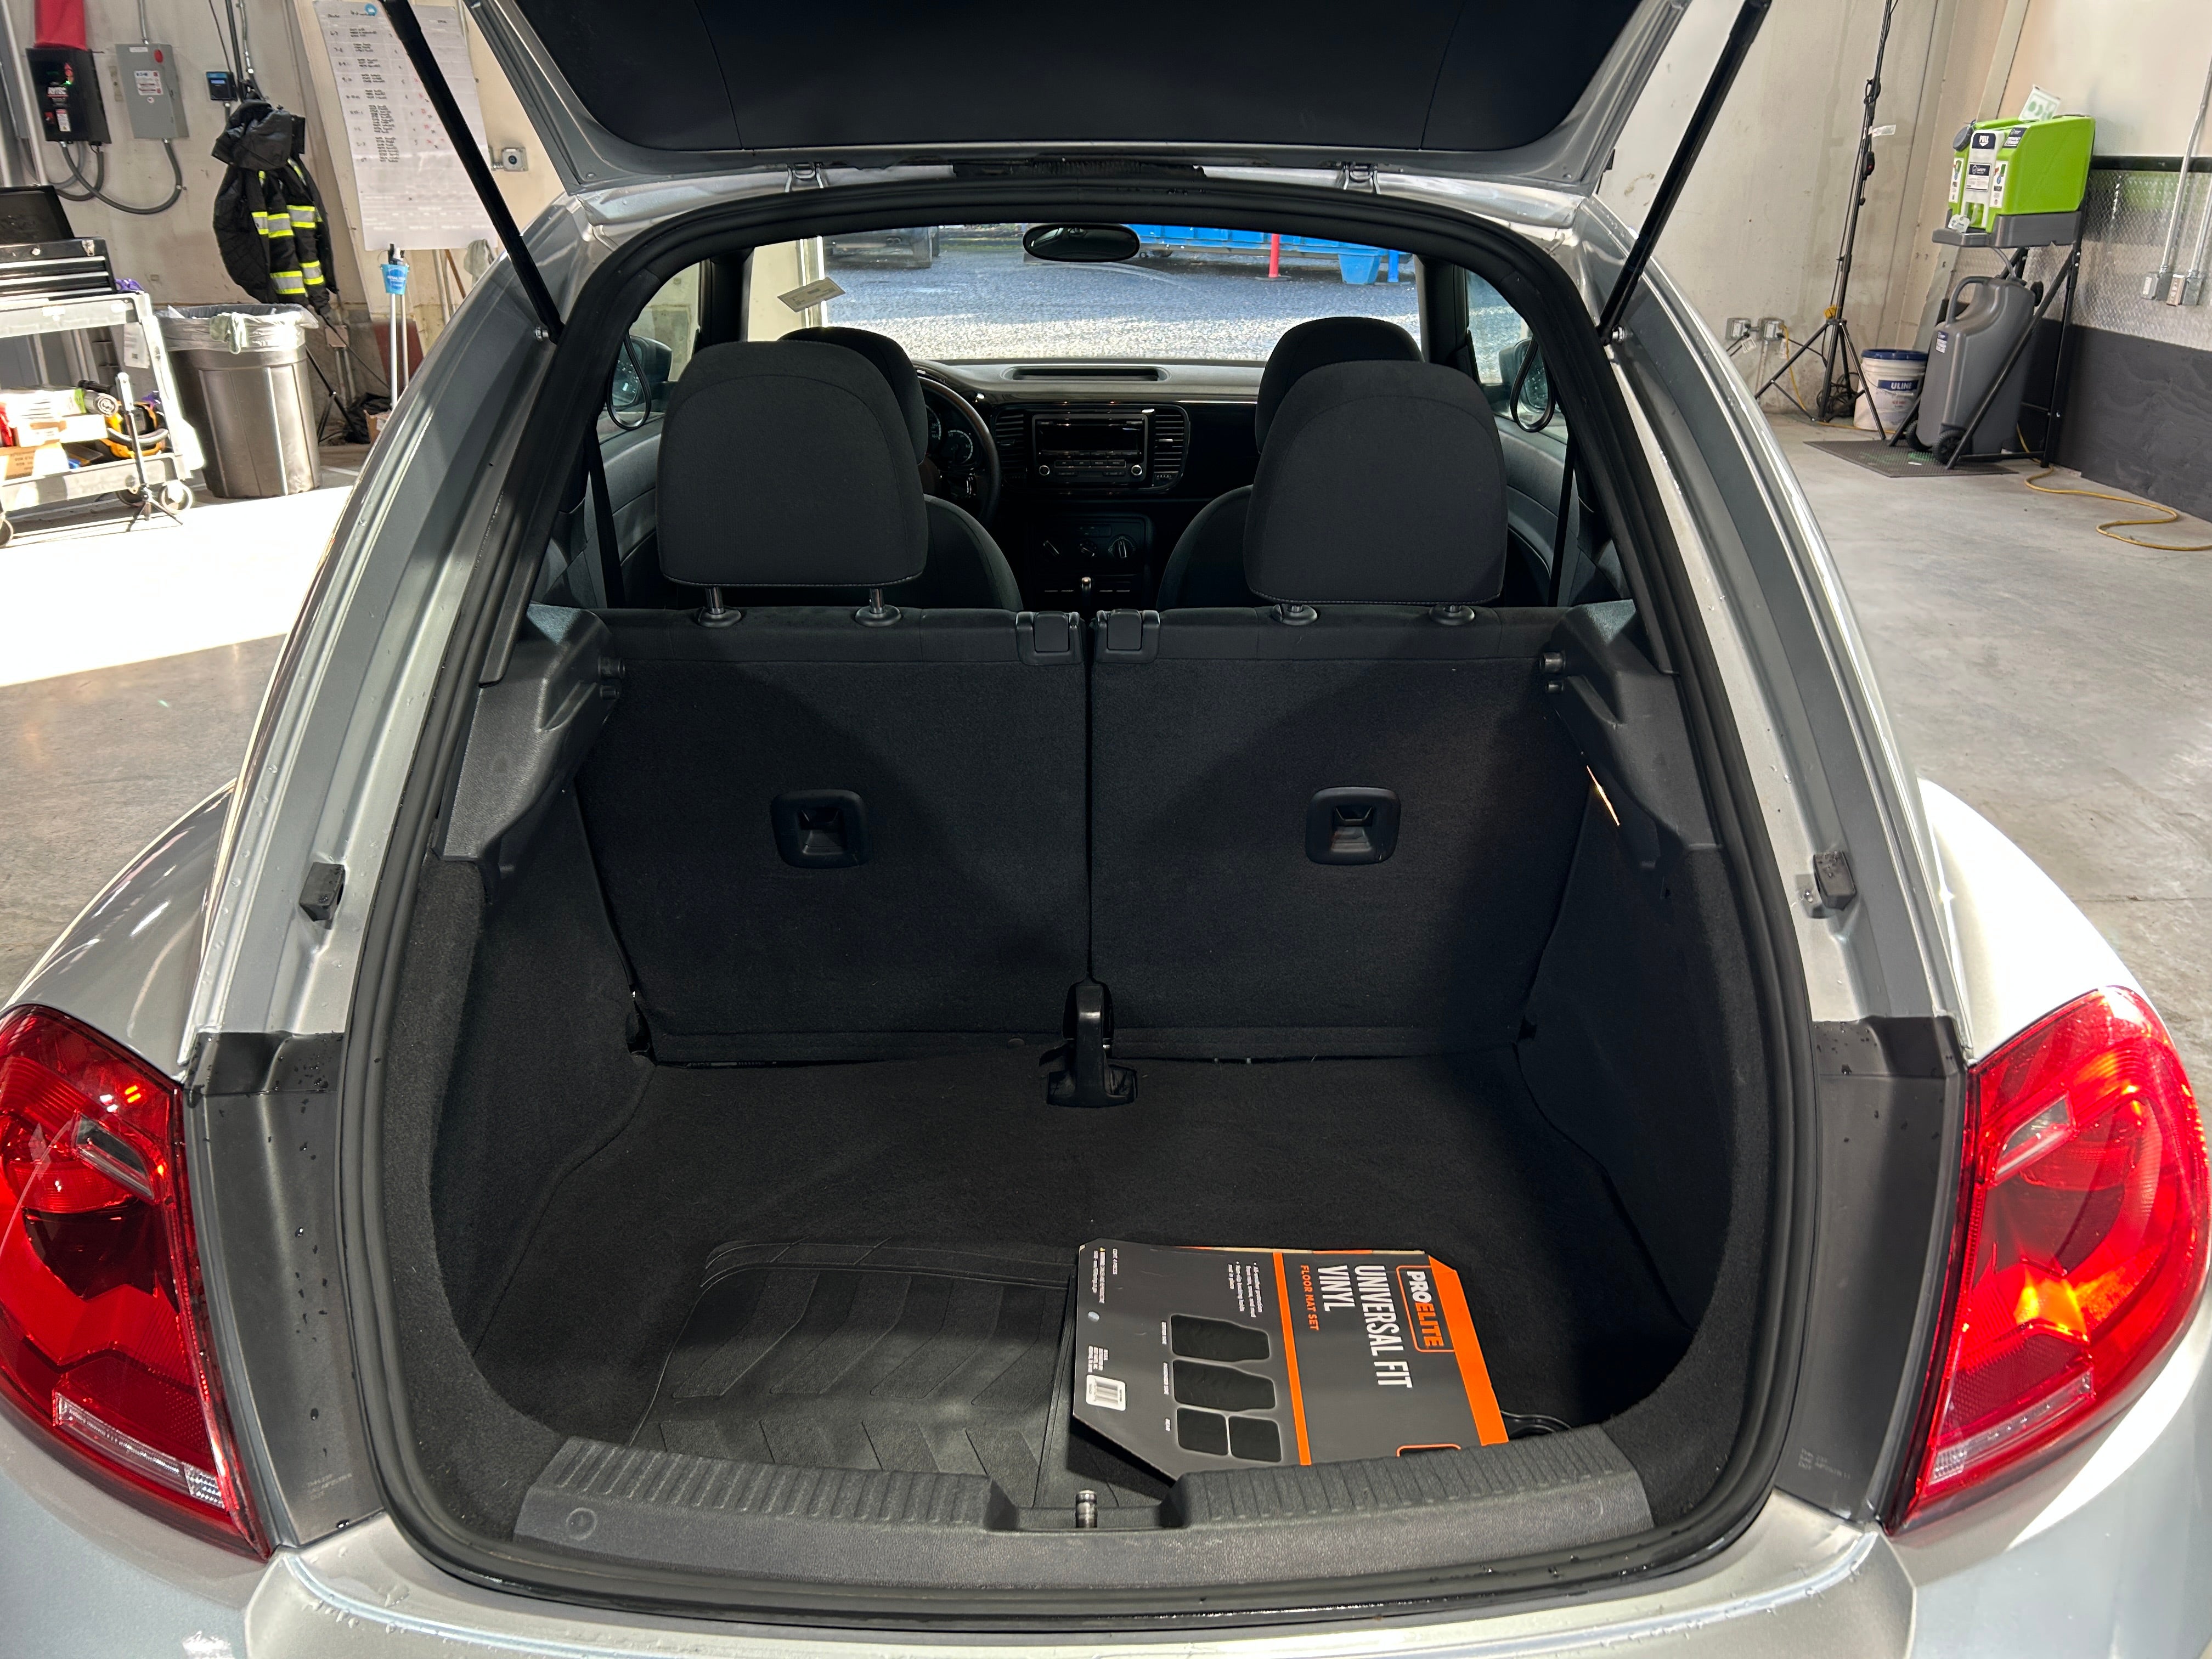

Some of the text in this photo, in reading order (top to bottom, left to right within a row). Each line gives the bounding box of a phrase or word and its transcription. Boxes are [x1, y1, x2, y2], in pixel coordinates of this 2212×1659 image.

[1300, 1264, 1319, 1331] FLOOR MAT SET
[1317, 1265, 1356, 1312] VINYL
[1406, 1271, 1444, 1347] PROELITE
[1355, 1265, 1413, 1389] UNIVERSAL FIT
